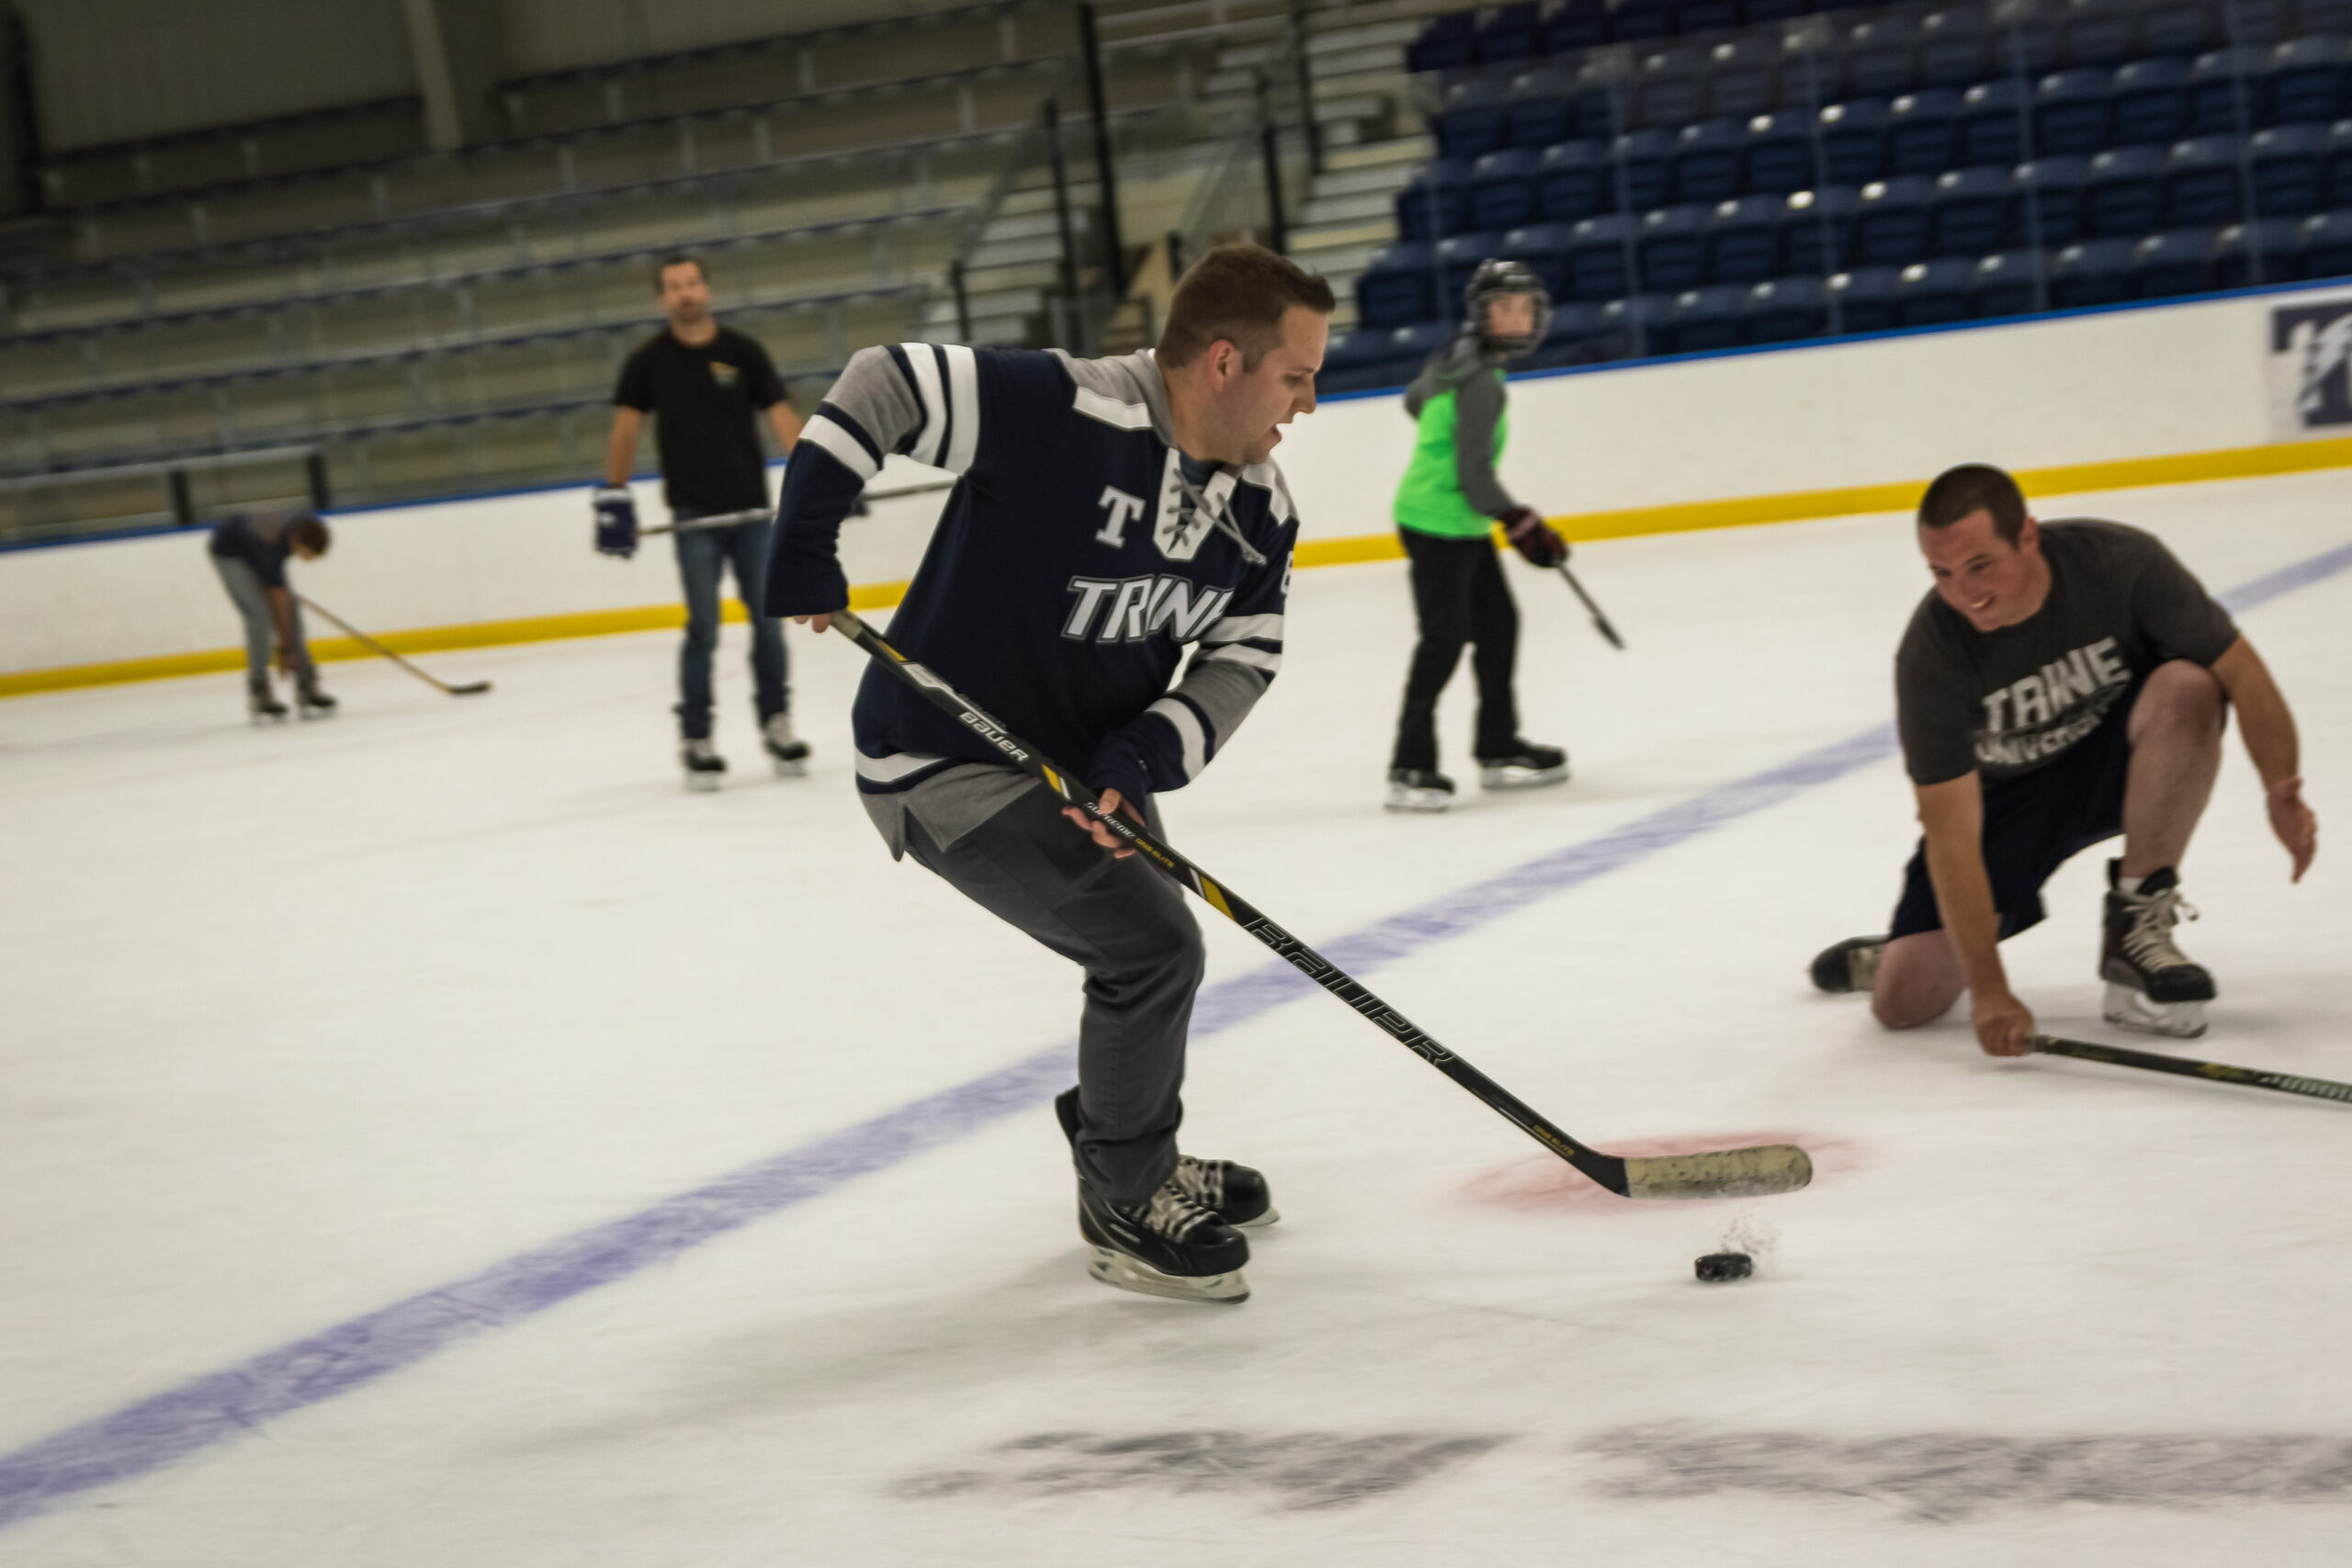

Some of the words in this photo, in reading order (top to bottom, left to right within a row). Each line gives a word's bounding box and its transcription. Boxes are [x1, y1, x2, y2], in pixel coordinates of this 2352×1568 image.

[1095, 485, 1147, 549] T
[1981, 636, 2132, 735] TRINE
[1243, 917, 1454, 1066] BAUER
